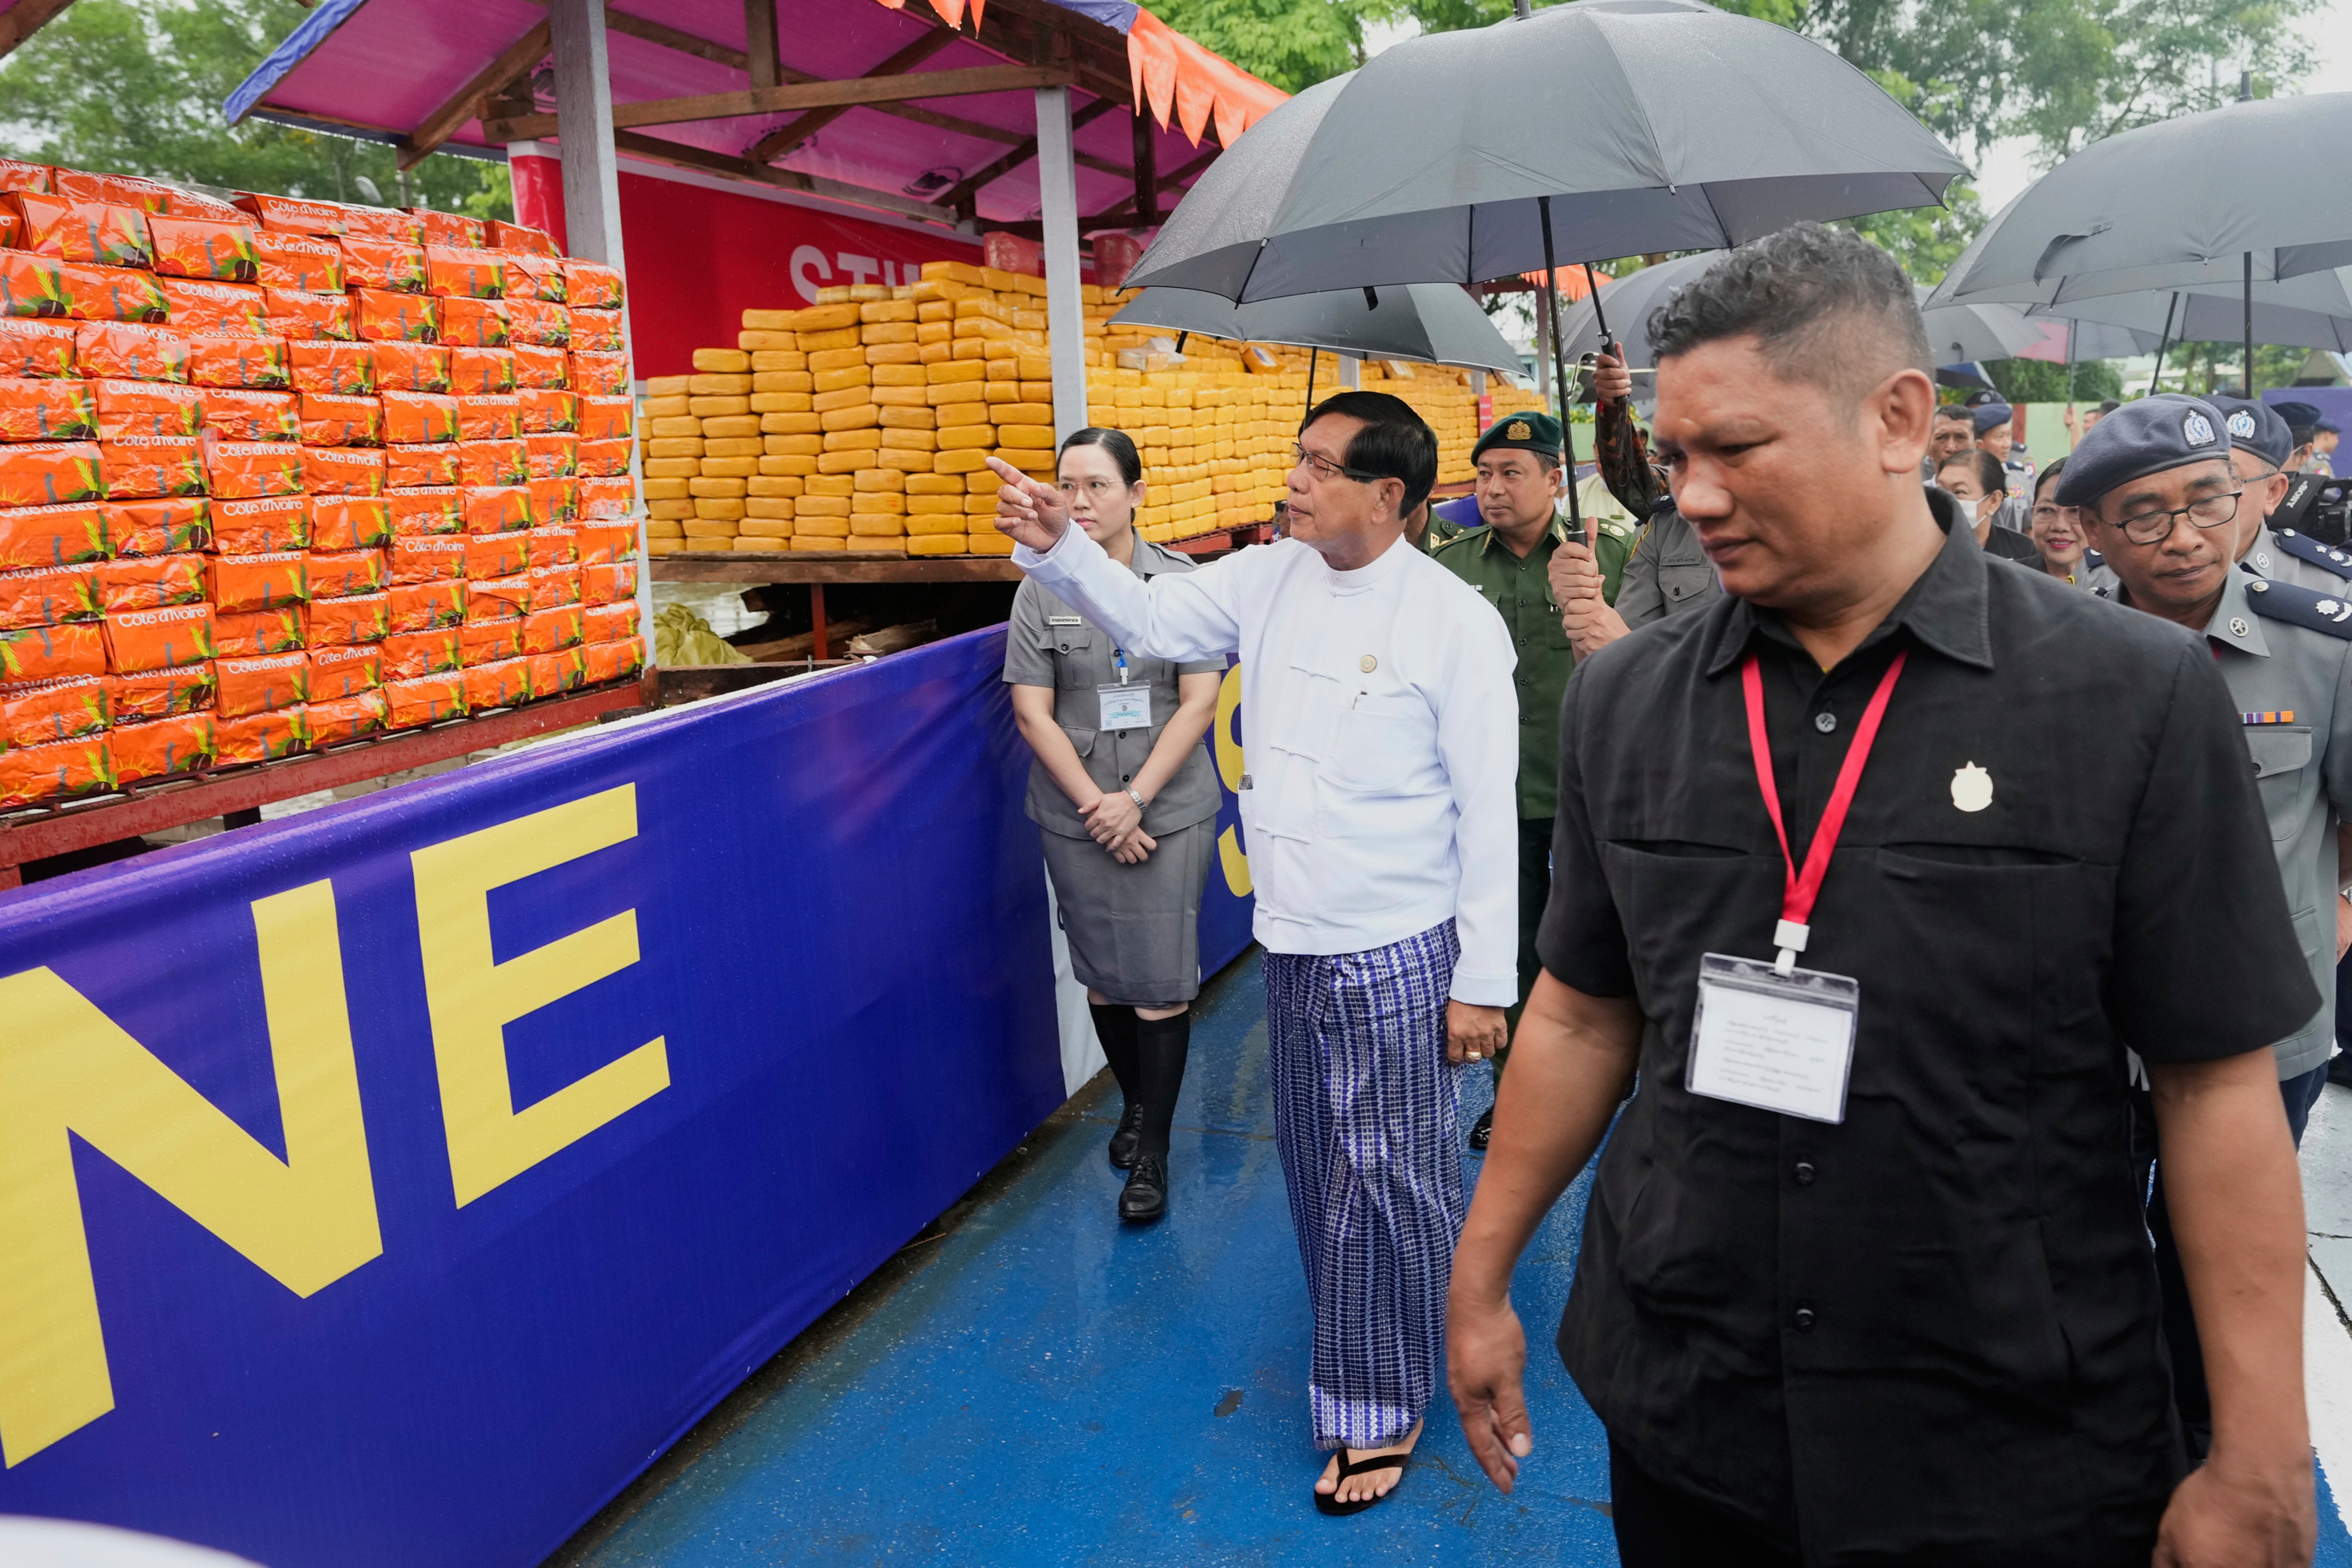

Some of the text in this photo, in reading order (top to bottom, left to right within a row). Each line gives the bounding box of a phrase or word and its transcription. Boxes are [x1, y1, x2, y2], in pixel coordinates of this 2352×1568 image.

[177, 282, 213, 295] Côte
[106, 380, 146, 394] Côte
[223, 499, 303, 516] Côte d'Ivoire
[405, 541, 431, 552] Côte
[119, 614, 157, 627] Côte
[159, 607, 207, 622] d'Ivoire
[227, 661, 262, 675] Côte
